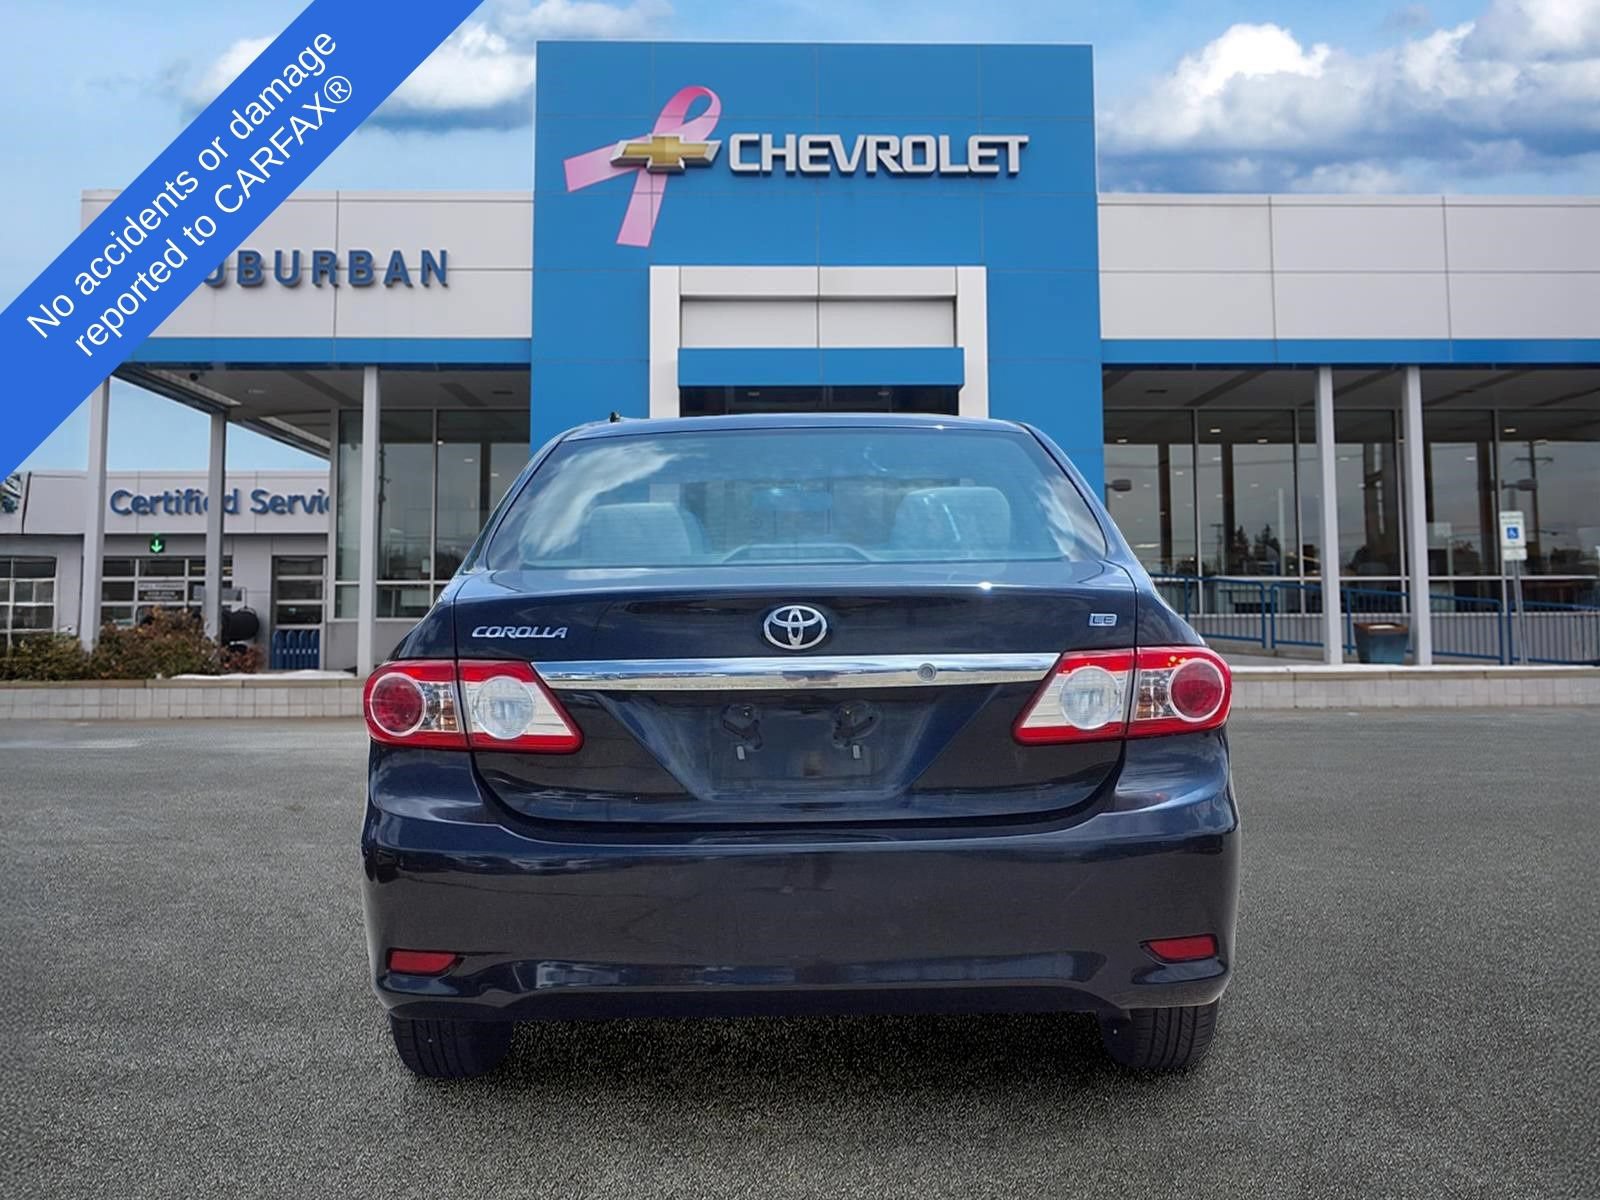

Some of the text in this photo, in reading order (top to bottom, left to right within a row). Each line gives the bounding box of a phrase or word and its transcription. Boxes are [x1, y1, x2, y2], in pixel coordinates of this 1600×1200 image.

[728, 133, 1030, 176] CHEVROLET
[203, 249, 449, 288] UBURBAN
[471, 625, 569, 639] COROLLA
